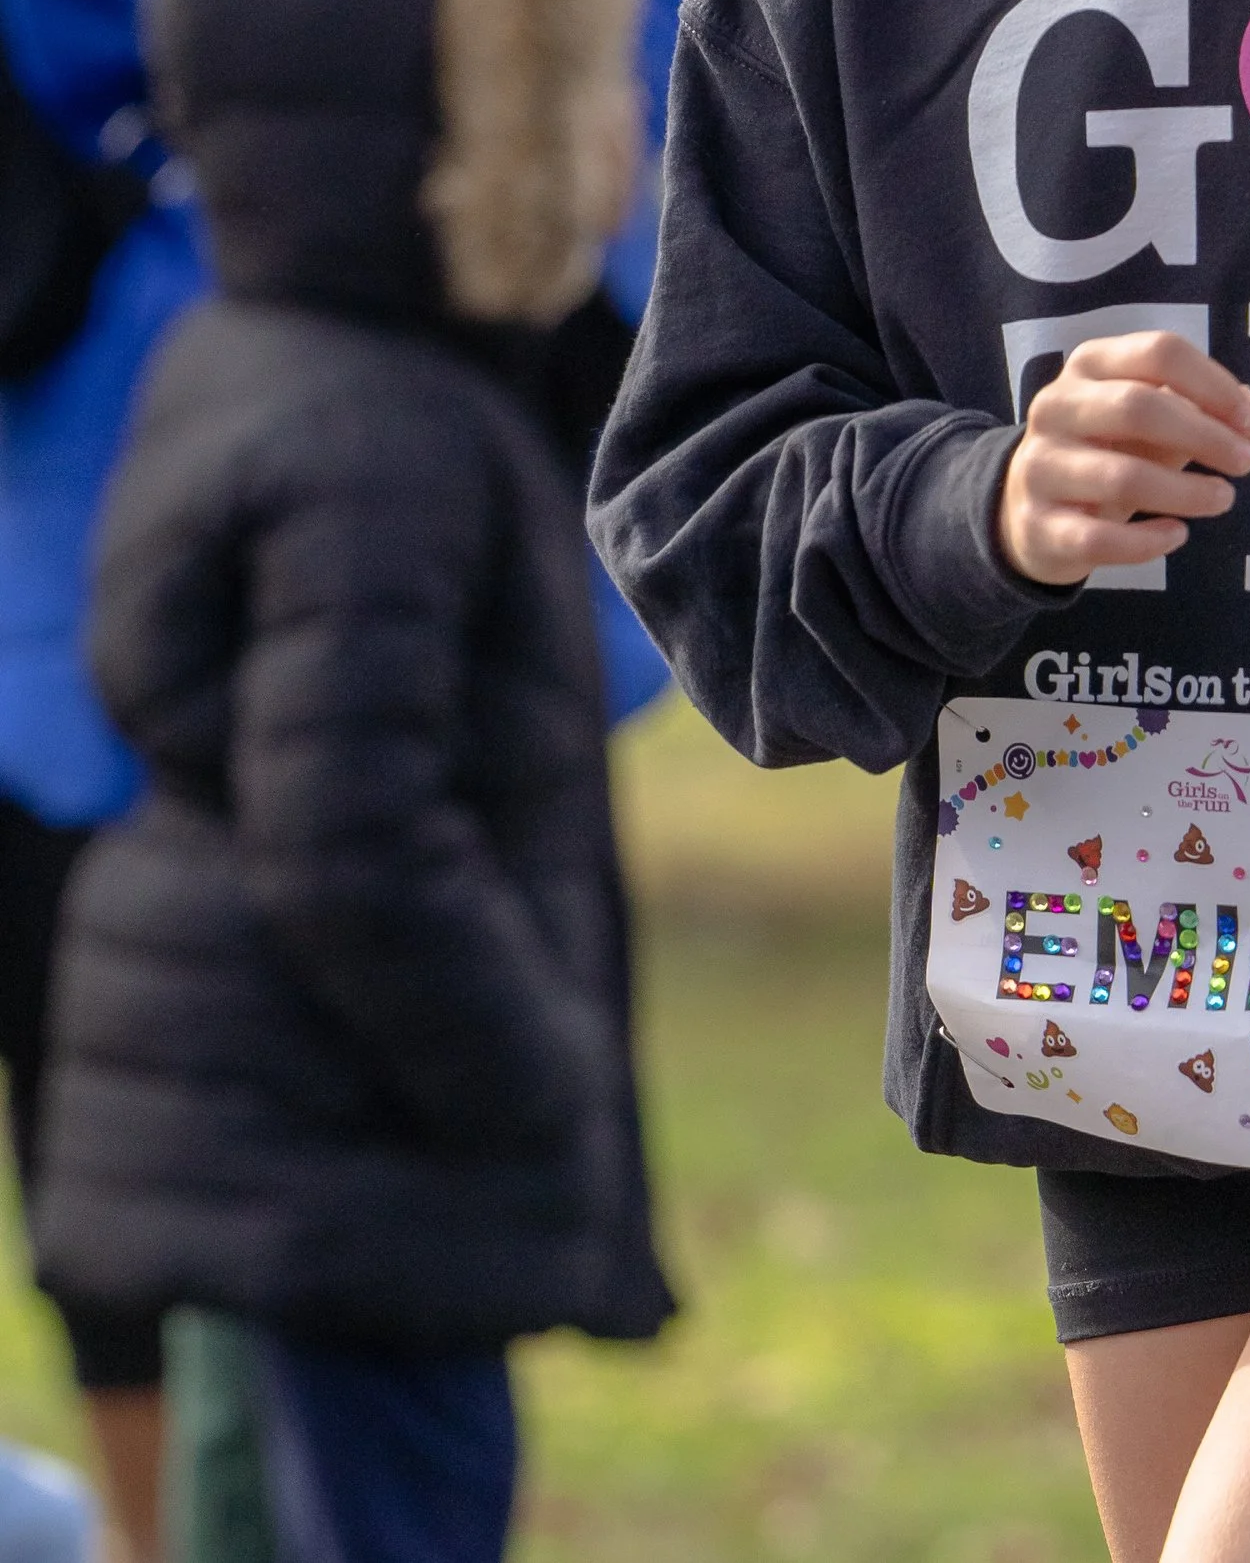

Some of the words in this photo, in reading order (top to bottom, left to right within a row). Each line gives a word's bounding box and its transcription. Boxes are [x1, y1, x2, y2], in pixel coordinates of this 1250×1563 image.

[1023, 649, 1172, 705] Girls
[1175, 674, 1225, 705] on
[1167, 780, 1218, 799] Girls
[1177, 799, 1192, 808] the
[1192, 799, 1231, 813] run
